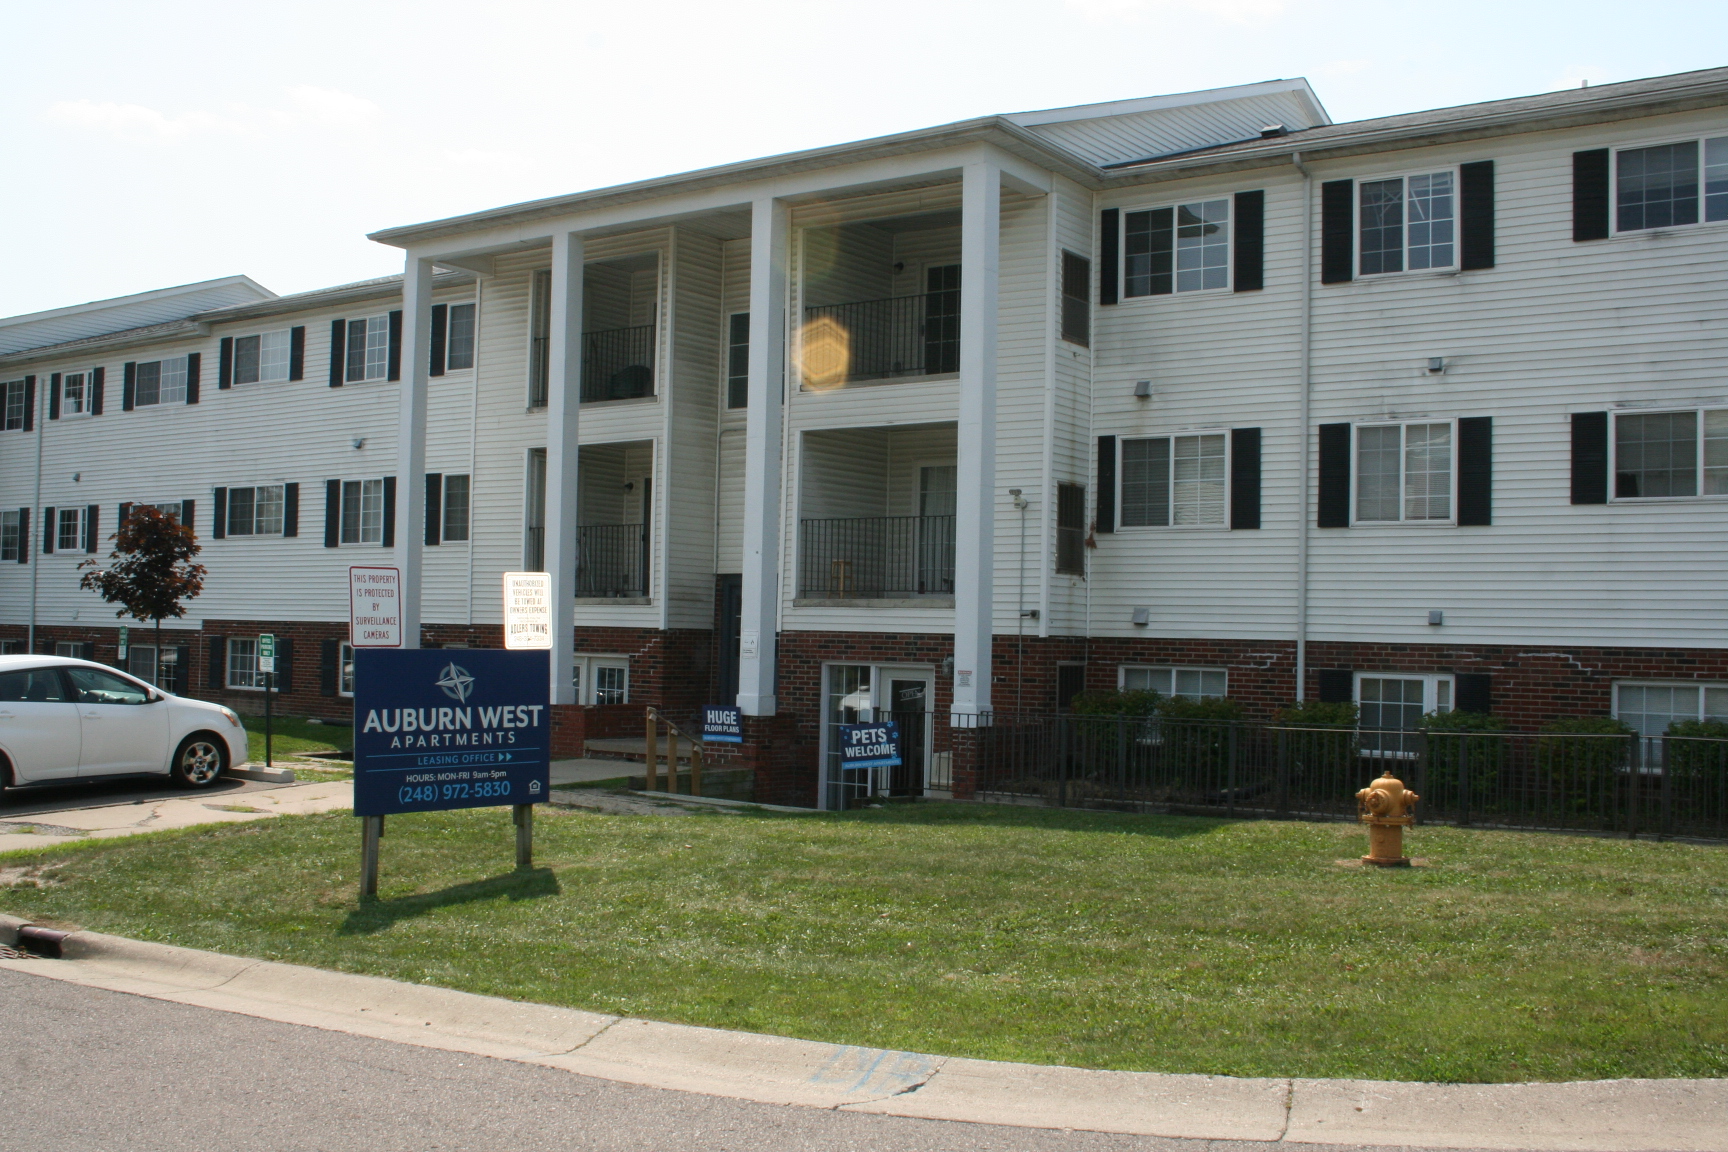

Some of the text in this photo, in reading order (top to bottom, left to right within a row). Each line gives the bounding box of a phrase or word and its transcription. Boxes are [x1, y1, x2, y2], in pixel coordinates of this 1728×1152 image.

[354, 574, 396, 584] THIS PROPERTY
[512, 579, 544, 587] UNAUTHORIZED
[356, 589, 395, 598] IS PROTECTED
[372, 603, 380, 611] BY
[355, 617, 397, 626] SURVEILLANCE
[363, 630, 390, 640] CAMERAS
[530, 623, 548, 635] TOWING
[363, 704, 543, 733] AUBURN WEST
[707, 710, 737, 725] HUGE
[704, 724, 740, 734] FLOOR PLANS
[391, 731, 515, 749] APARTMENTS
[852, 728, 887, 744] PETS
[845, 743, 897, 758] WELCOME
[417, 753, 495, 766] LEASING OFFICE
[406, 770, 507, 783] HOURS: MON-FRI 9am-5pm
[398, 780, 511, 804] (248) 972-5830
